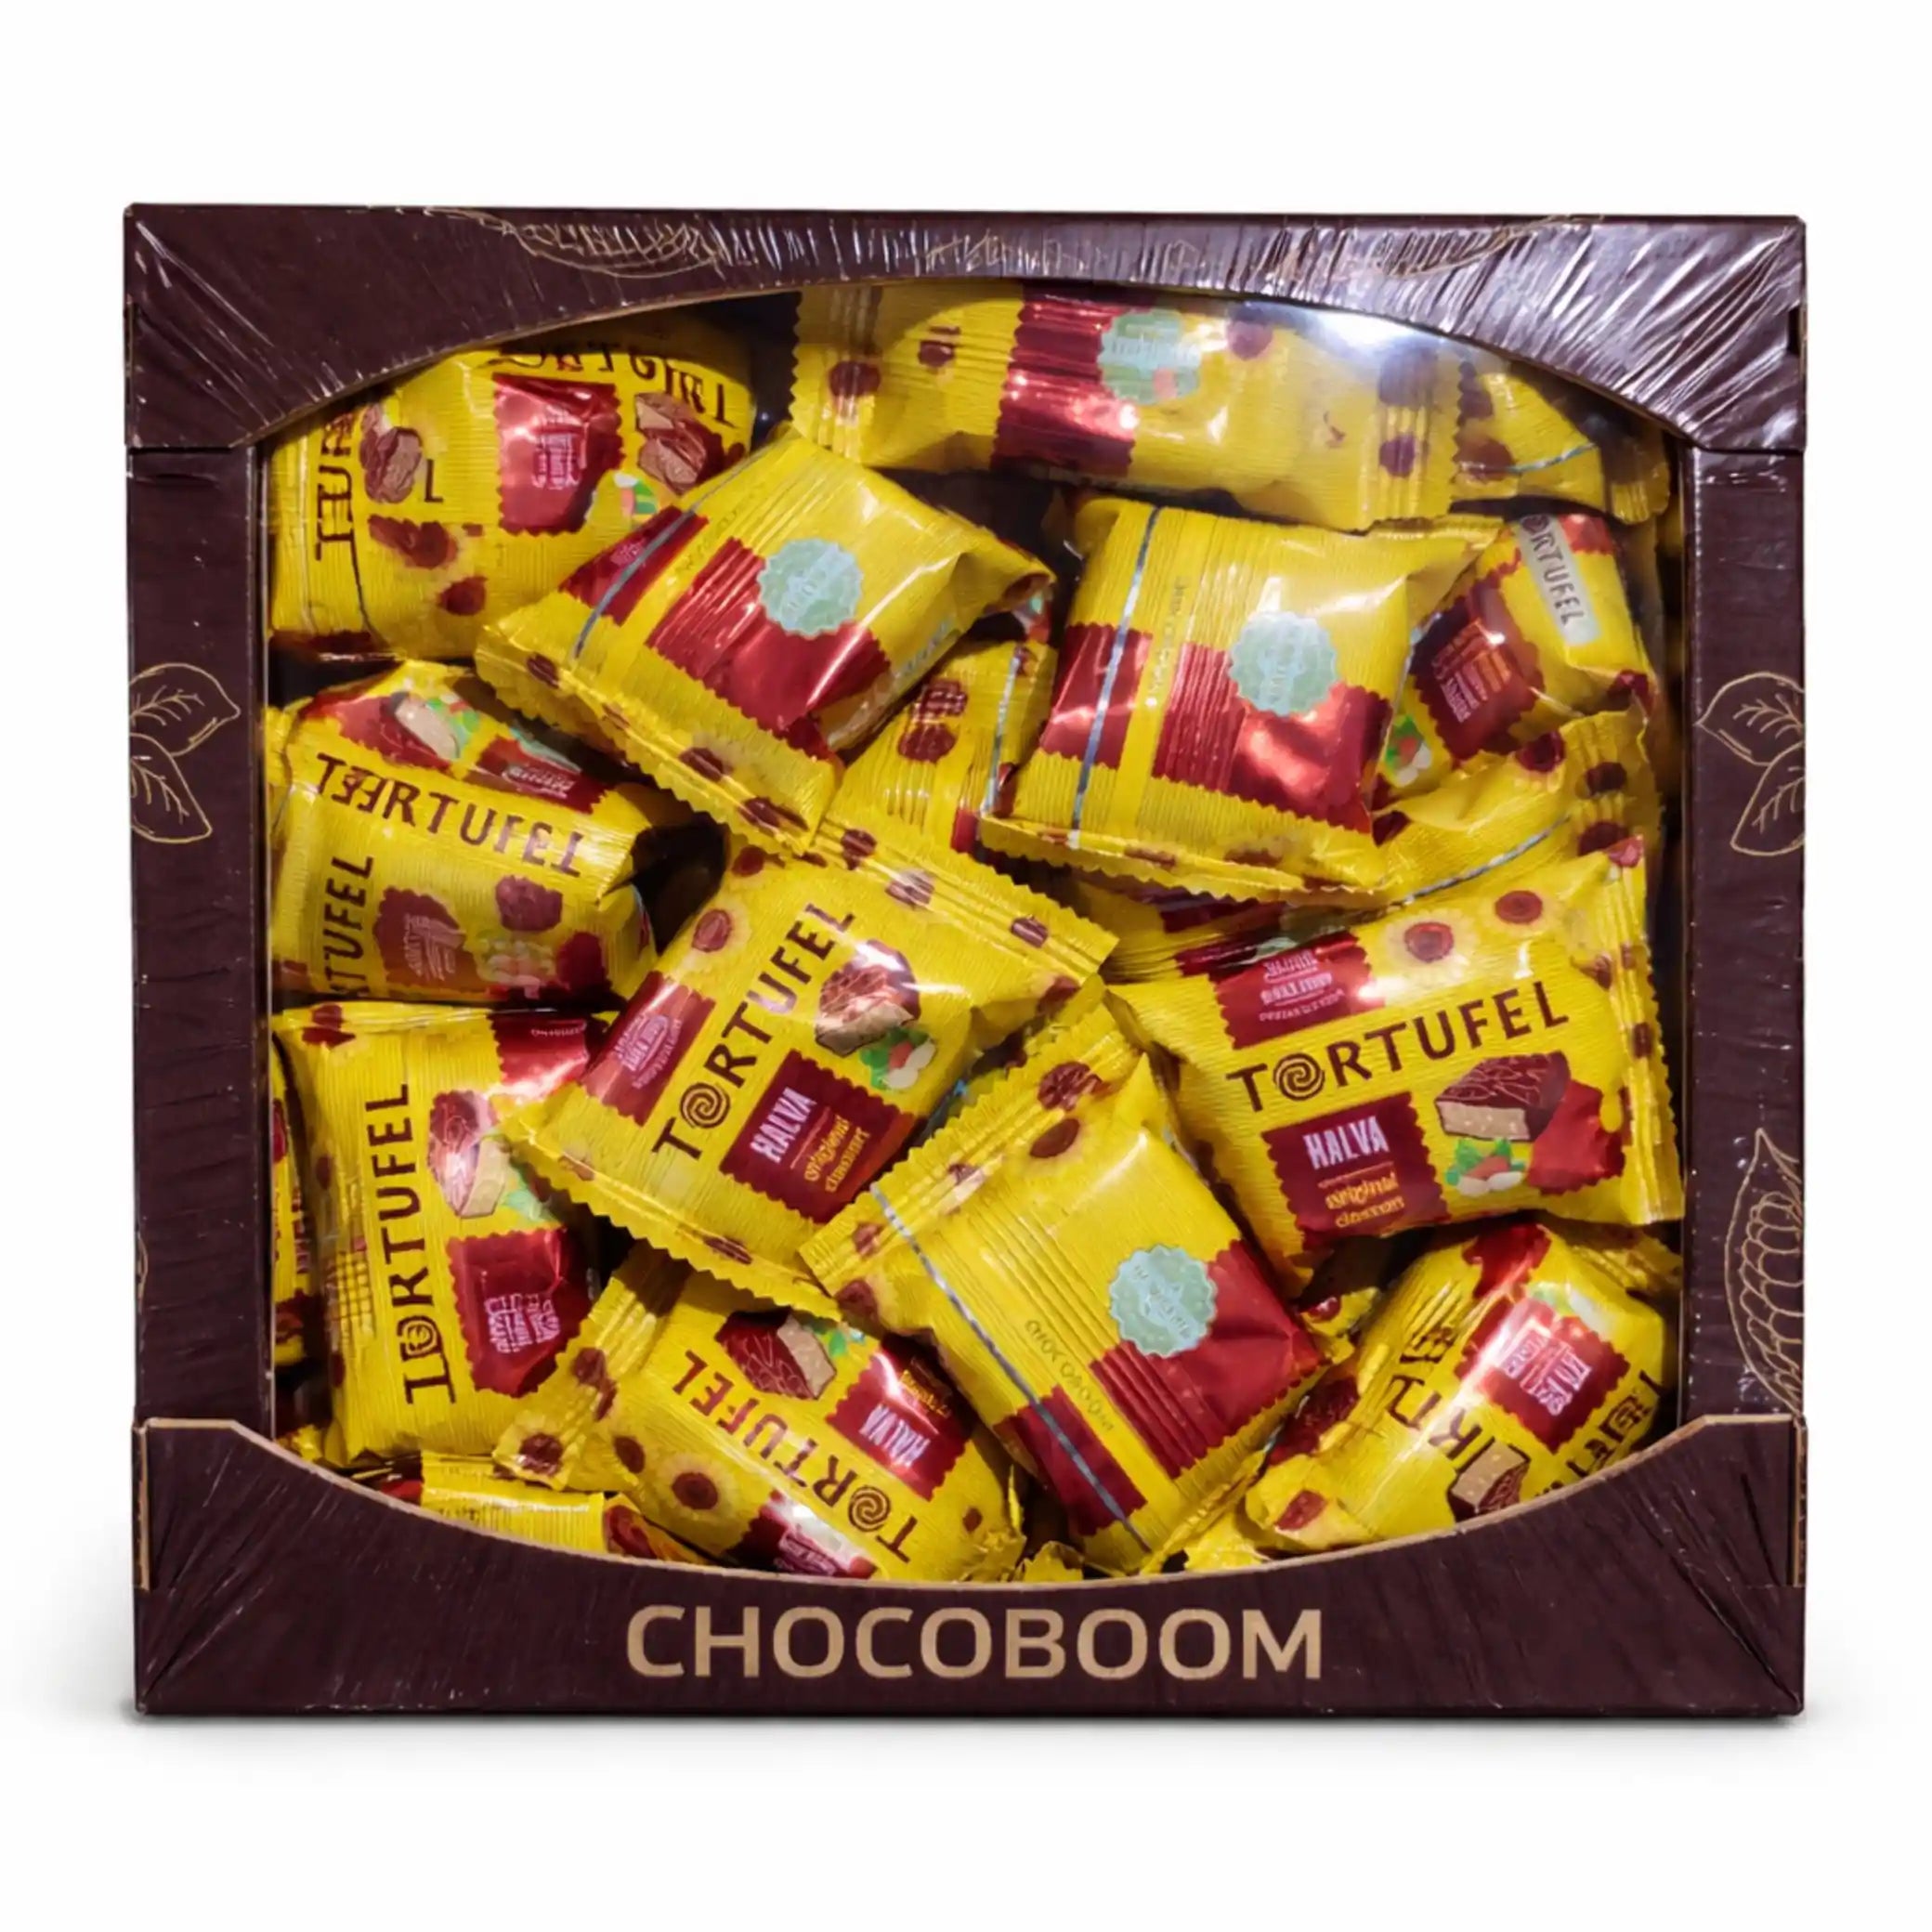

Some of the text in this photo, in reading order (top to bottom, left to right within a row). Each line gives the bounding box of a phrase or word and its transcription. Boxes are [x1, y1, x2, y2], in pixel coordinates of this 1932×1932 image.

[651, 903, 856, 1161] TORTUFEL
[1225, 980, 1570, 1113] TORTUFEL
[750, 1087, 817, 1164] HALVA
[1302, 1115, 1390, 1170] HALVA
[672, 1350, 918, 1563] TORTUFEL
[626, 1604, 1325, 1681] CHOCOBOOM
